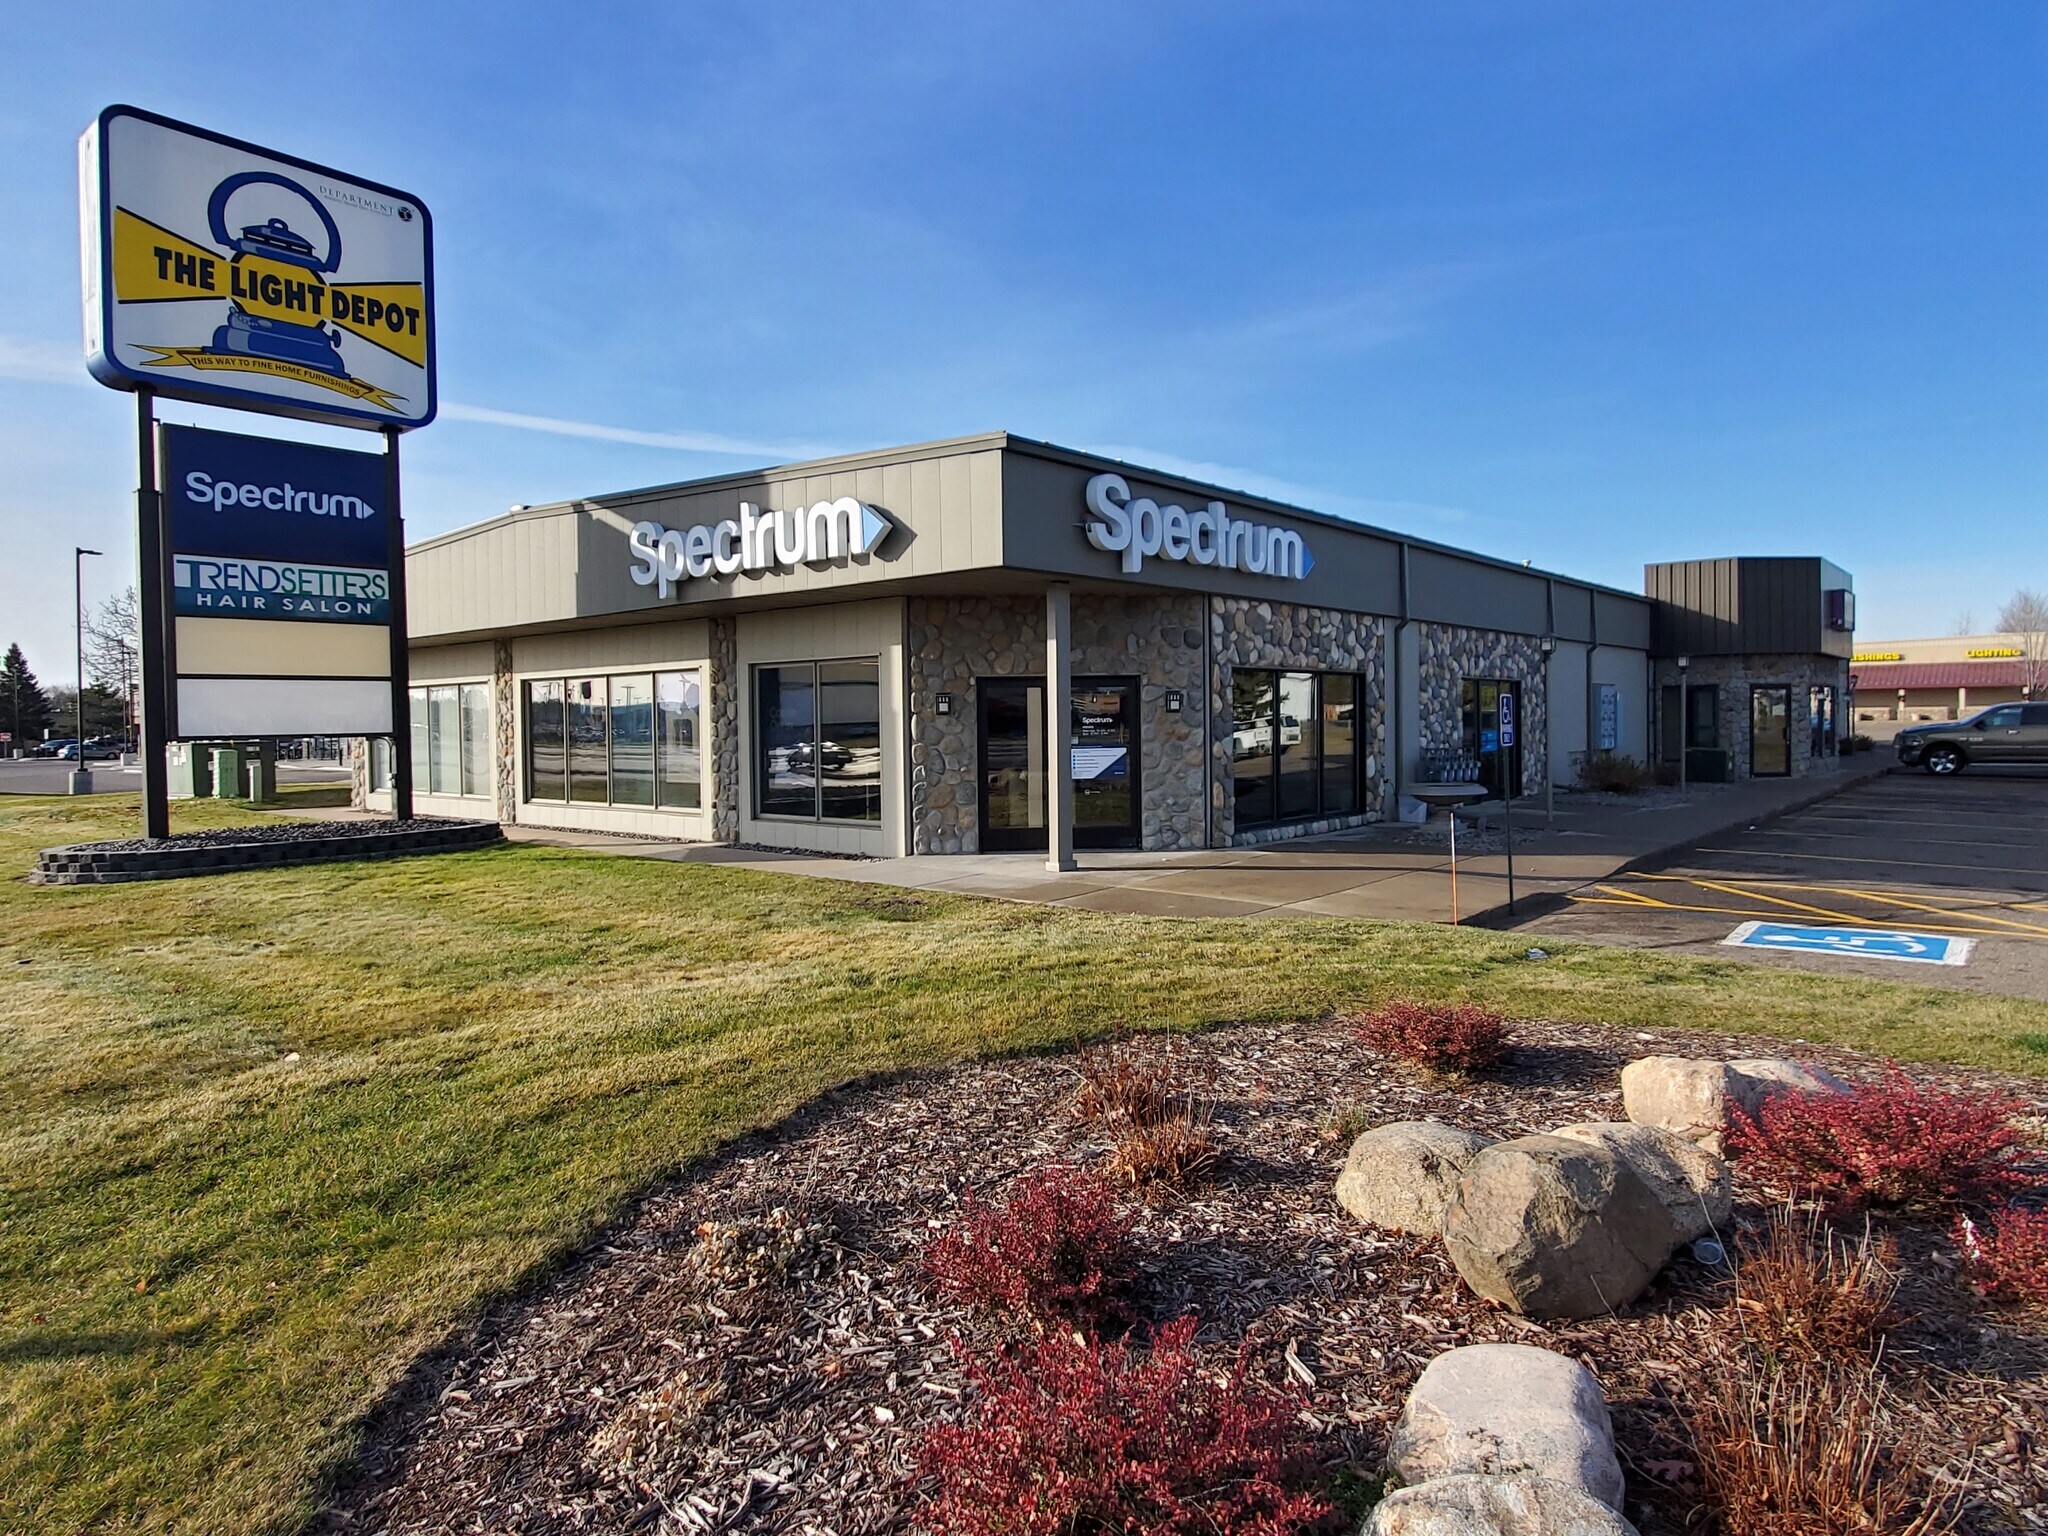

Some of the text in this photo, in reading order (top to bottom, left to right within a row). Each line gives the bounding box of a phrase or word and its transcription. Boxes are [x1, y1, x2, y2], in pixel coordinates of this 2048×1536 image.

[319, 185, 394, 215] DEPARTMENT
[153, 246, 420, 336] THE LIGHT DEPOT
[191, 357, 361, 396] THIS WAY TO FINE HOME FURNISHINGS
[185, 471, 365, 520] Spectrum
[1085, 473, 1304, 581] Spectrum
[629, 496, 866, 600] Spectrum
[175, 559, 387, 600] TRENDSETTERS
[196, 593, 373, 616] HAIR SALON
[1851, 648, 2021, 661] ISHINGS LIGHTING
[1082, 716, 1112, 725] Spectrum
